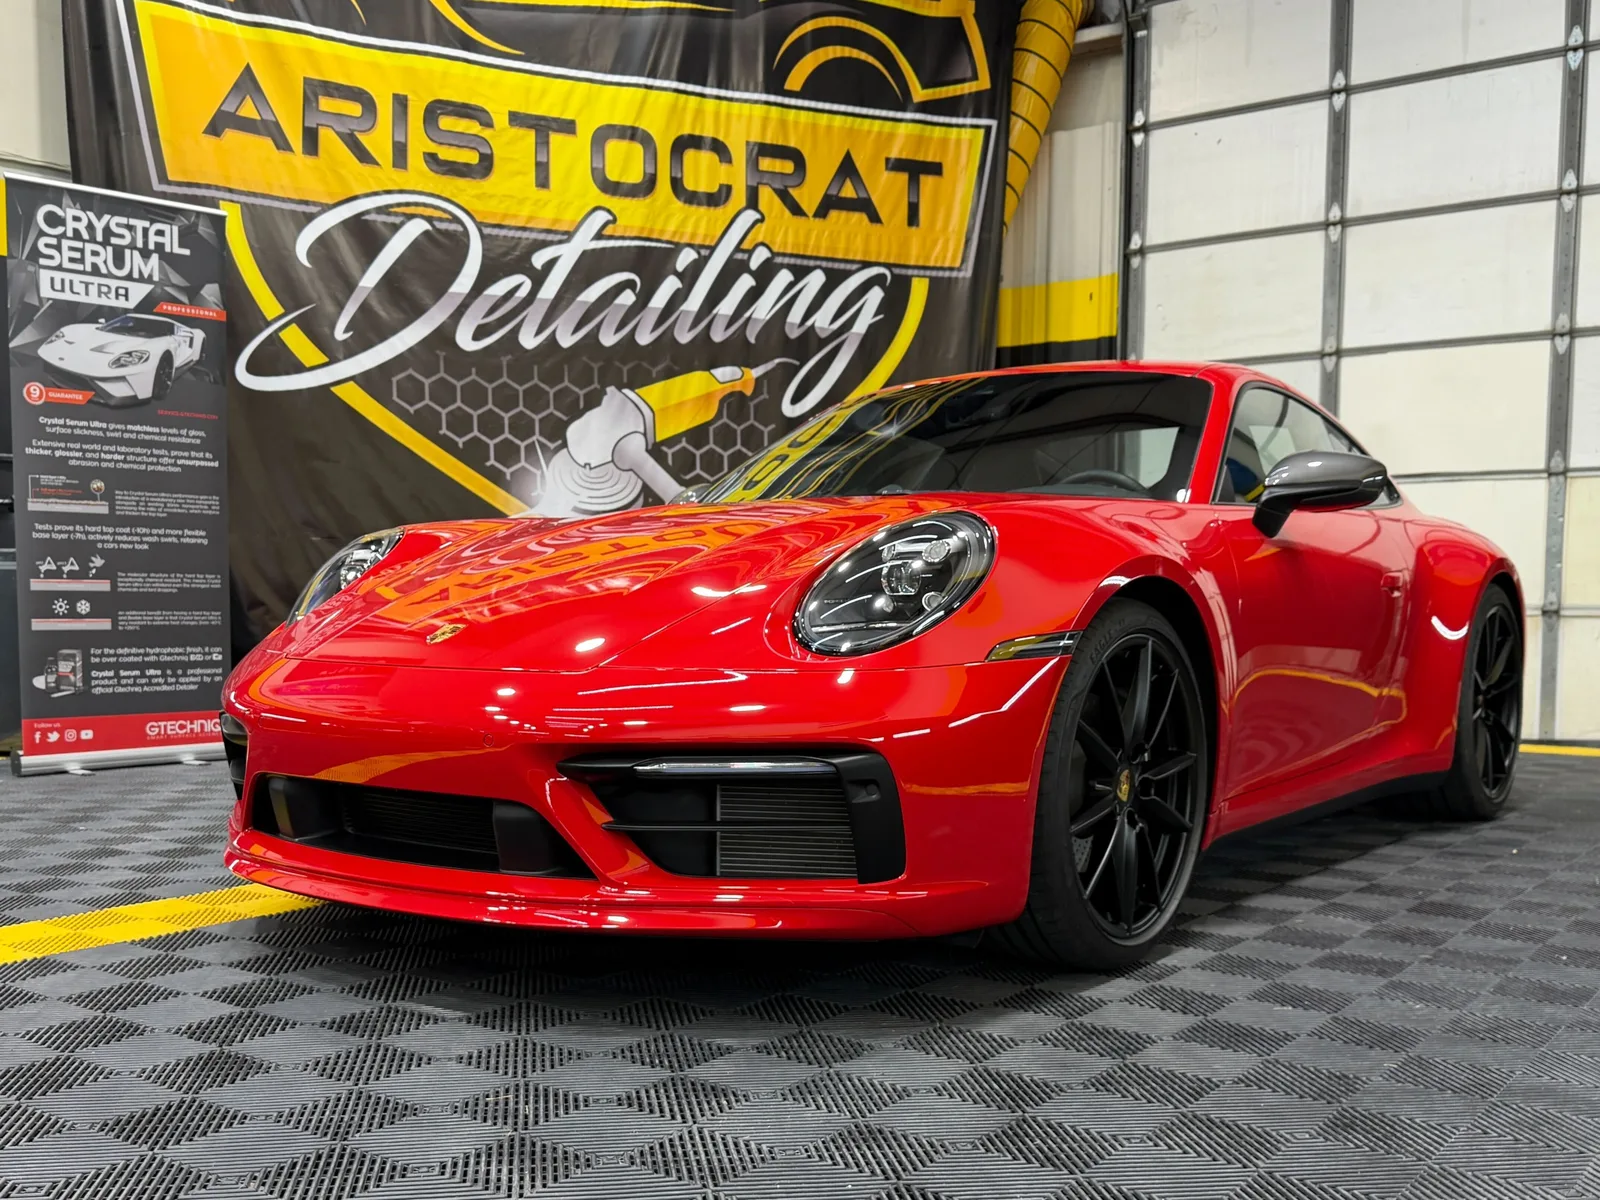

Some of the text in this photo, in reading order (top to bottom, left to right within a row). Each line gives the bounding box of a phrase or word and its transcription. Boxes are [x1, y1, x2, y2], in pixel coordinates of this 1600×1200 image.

[203, 62, 943, 228] ARISTOCRAT
[36, 203, 191, 256] CRYSTAL
[36, 236, 160, 282] SERUM
[50, 276, 130, 302] ULTRA
[162, 304, 217, 317] PROFESSIONAL
[234, 190, 892, 418] Detailing
[30, 385, 41, 398] 9
[48, 391, 84, 400] GUARANTEE
[39, 416, 64, 427] Crystal
[66, 418, 88, 427] Serum
[89, 420, 107, 429] Ultra
[108, 422, 125, 432] gives
[127, 423, 159, 433] matchless
[161, 426, 178, 435] levels
[45, 425, 72, 434] surface
[106, 430, 121, 438] swirl
[138, 433, 166, 442] chemical
[168, 435, 201, 444] resistance
[32, 439, 65, 448] Extensive
[67, 441, 80, 449] real
[82, 442, 101, 451] world
[117, 445, 151, 456] laboratory
[170, 450, 189, 459] prove
[191, 450, 204, 458] that
[68, 459, 99, 467] abrasion
[116, 462, 146, 470] chemical
[147, 464, 181, 474] protection
[101, 452, 125, 461] harder
[126, 454, 157, 463] structure
[177, 458, 219, 469] unsurpassed
[52, 532, 68, 541] layer
[88, 534, 113, 542] actively
[180, 537, 208, 545] retaining
[184, 528, 206, 536] flexible
[146, 647, 185, 655] hydrophobic
[91, 669, 114, 678] Crystal
[188, 668, 222, 676] professional
[92, 678, 118, 686] product
[151, 677, 165, 685] only
[179, 676, 201, 684] applied
[92, 686, 113, 694] official
[145, 718, 222, 735] GTECHNIQ
